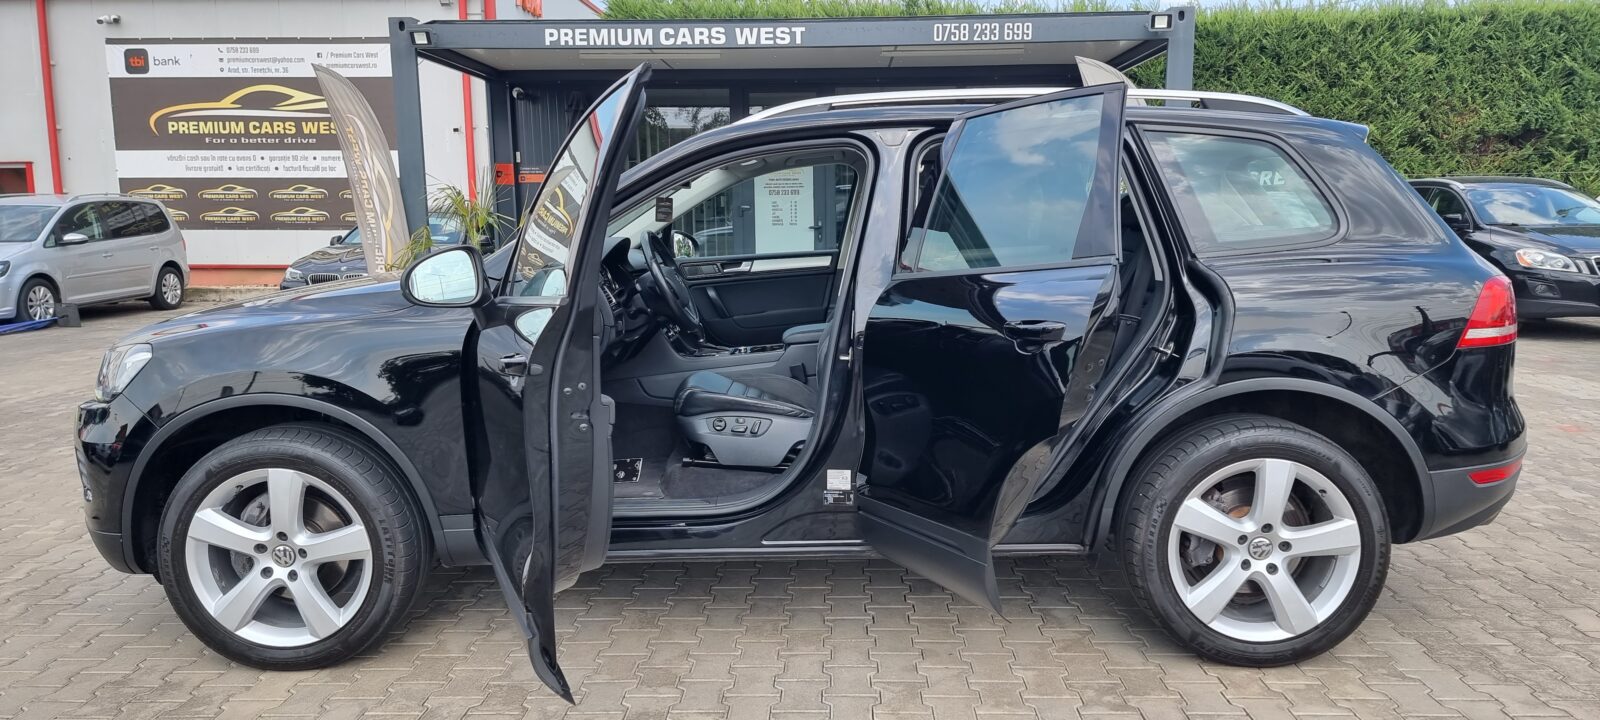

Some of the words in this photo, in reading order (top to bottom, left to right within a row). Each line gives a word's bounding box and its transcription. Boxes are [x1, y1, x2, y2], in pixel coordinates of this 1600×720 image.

[544, 28, 653, 46] PREMIUM
[659, 27, 726, 45] CARS
[735, 27, 805, 45] WEST
[933, 23, 969, 41] 0758
[973, 23, 999, 40] 233
[1004, 22, 1033, 40] 699
[129, 57, 145, 67] tbi
[153, 56, 181, 66] bank
[167, 121, 245, 134] PREMIUM
[249, 121, 297, 134] CARS
[302, 121, 336, 134] WES
